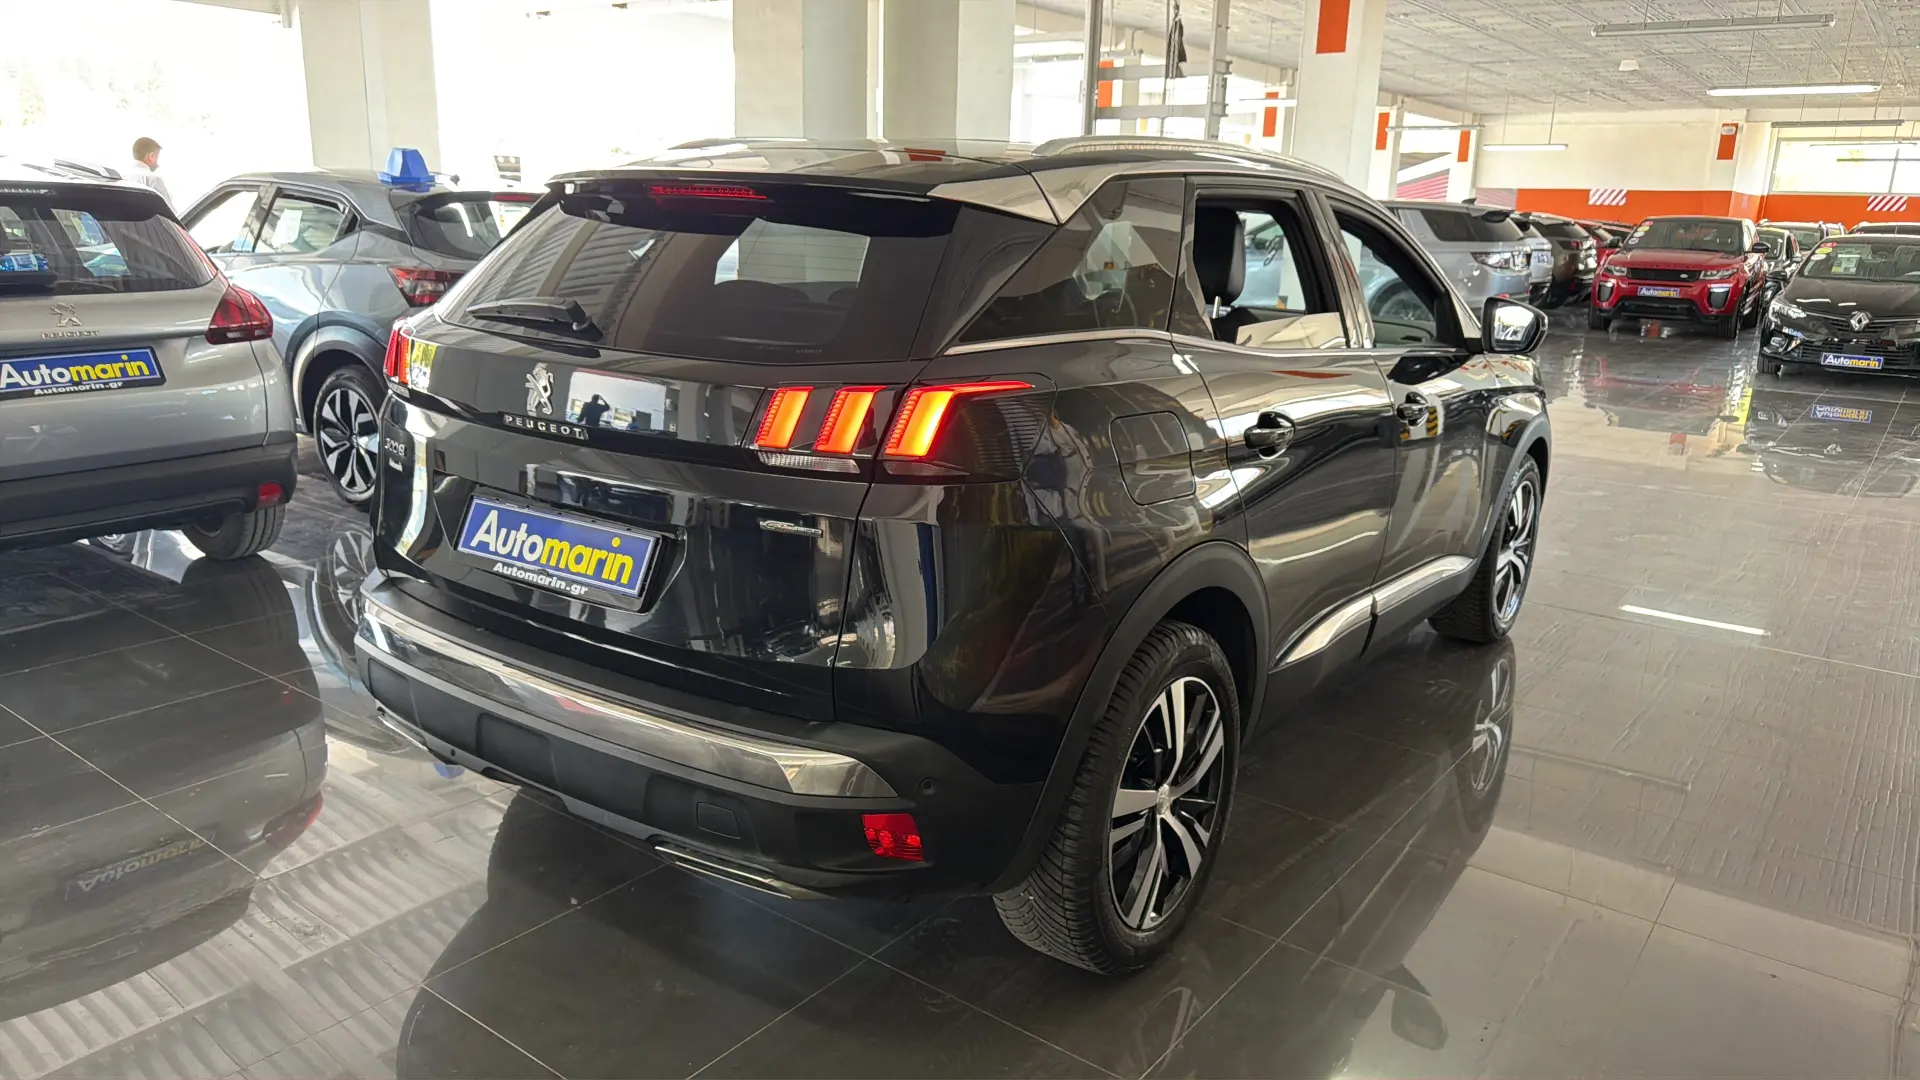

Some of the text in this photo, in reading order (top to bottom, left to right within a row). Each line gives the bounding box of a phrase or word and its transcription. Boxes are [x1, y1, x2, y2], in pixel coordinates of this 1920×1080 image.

[0, 354, 150, 389] Automarin
[1825, 354, 1879, 368] Automarin
[33, 382, 123, 396] Automarin.gr
[503, 414, 586, 440] PEUGEOT
[469, 509, 634, 585] Automarin
[492, 562, 588, 596] Automarin.gr
